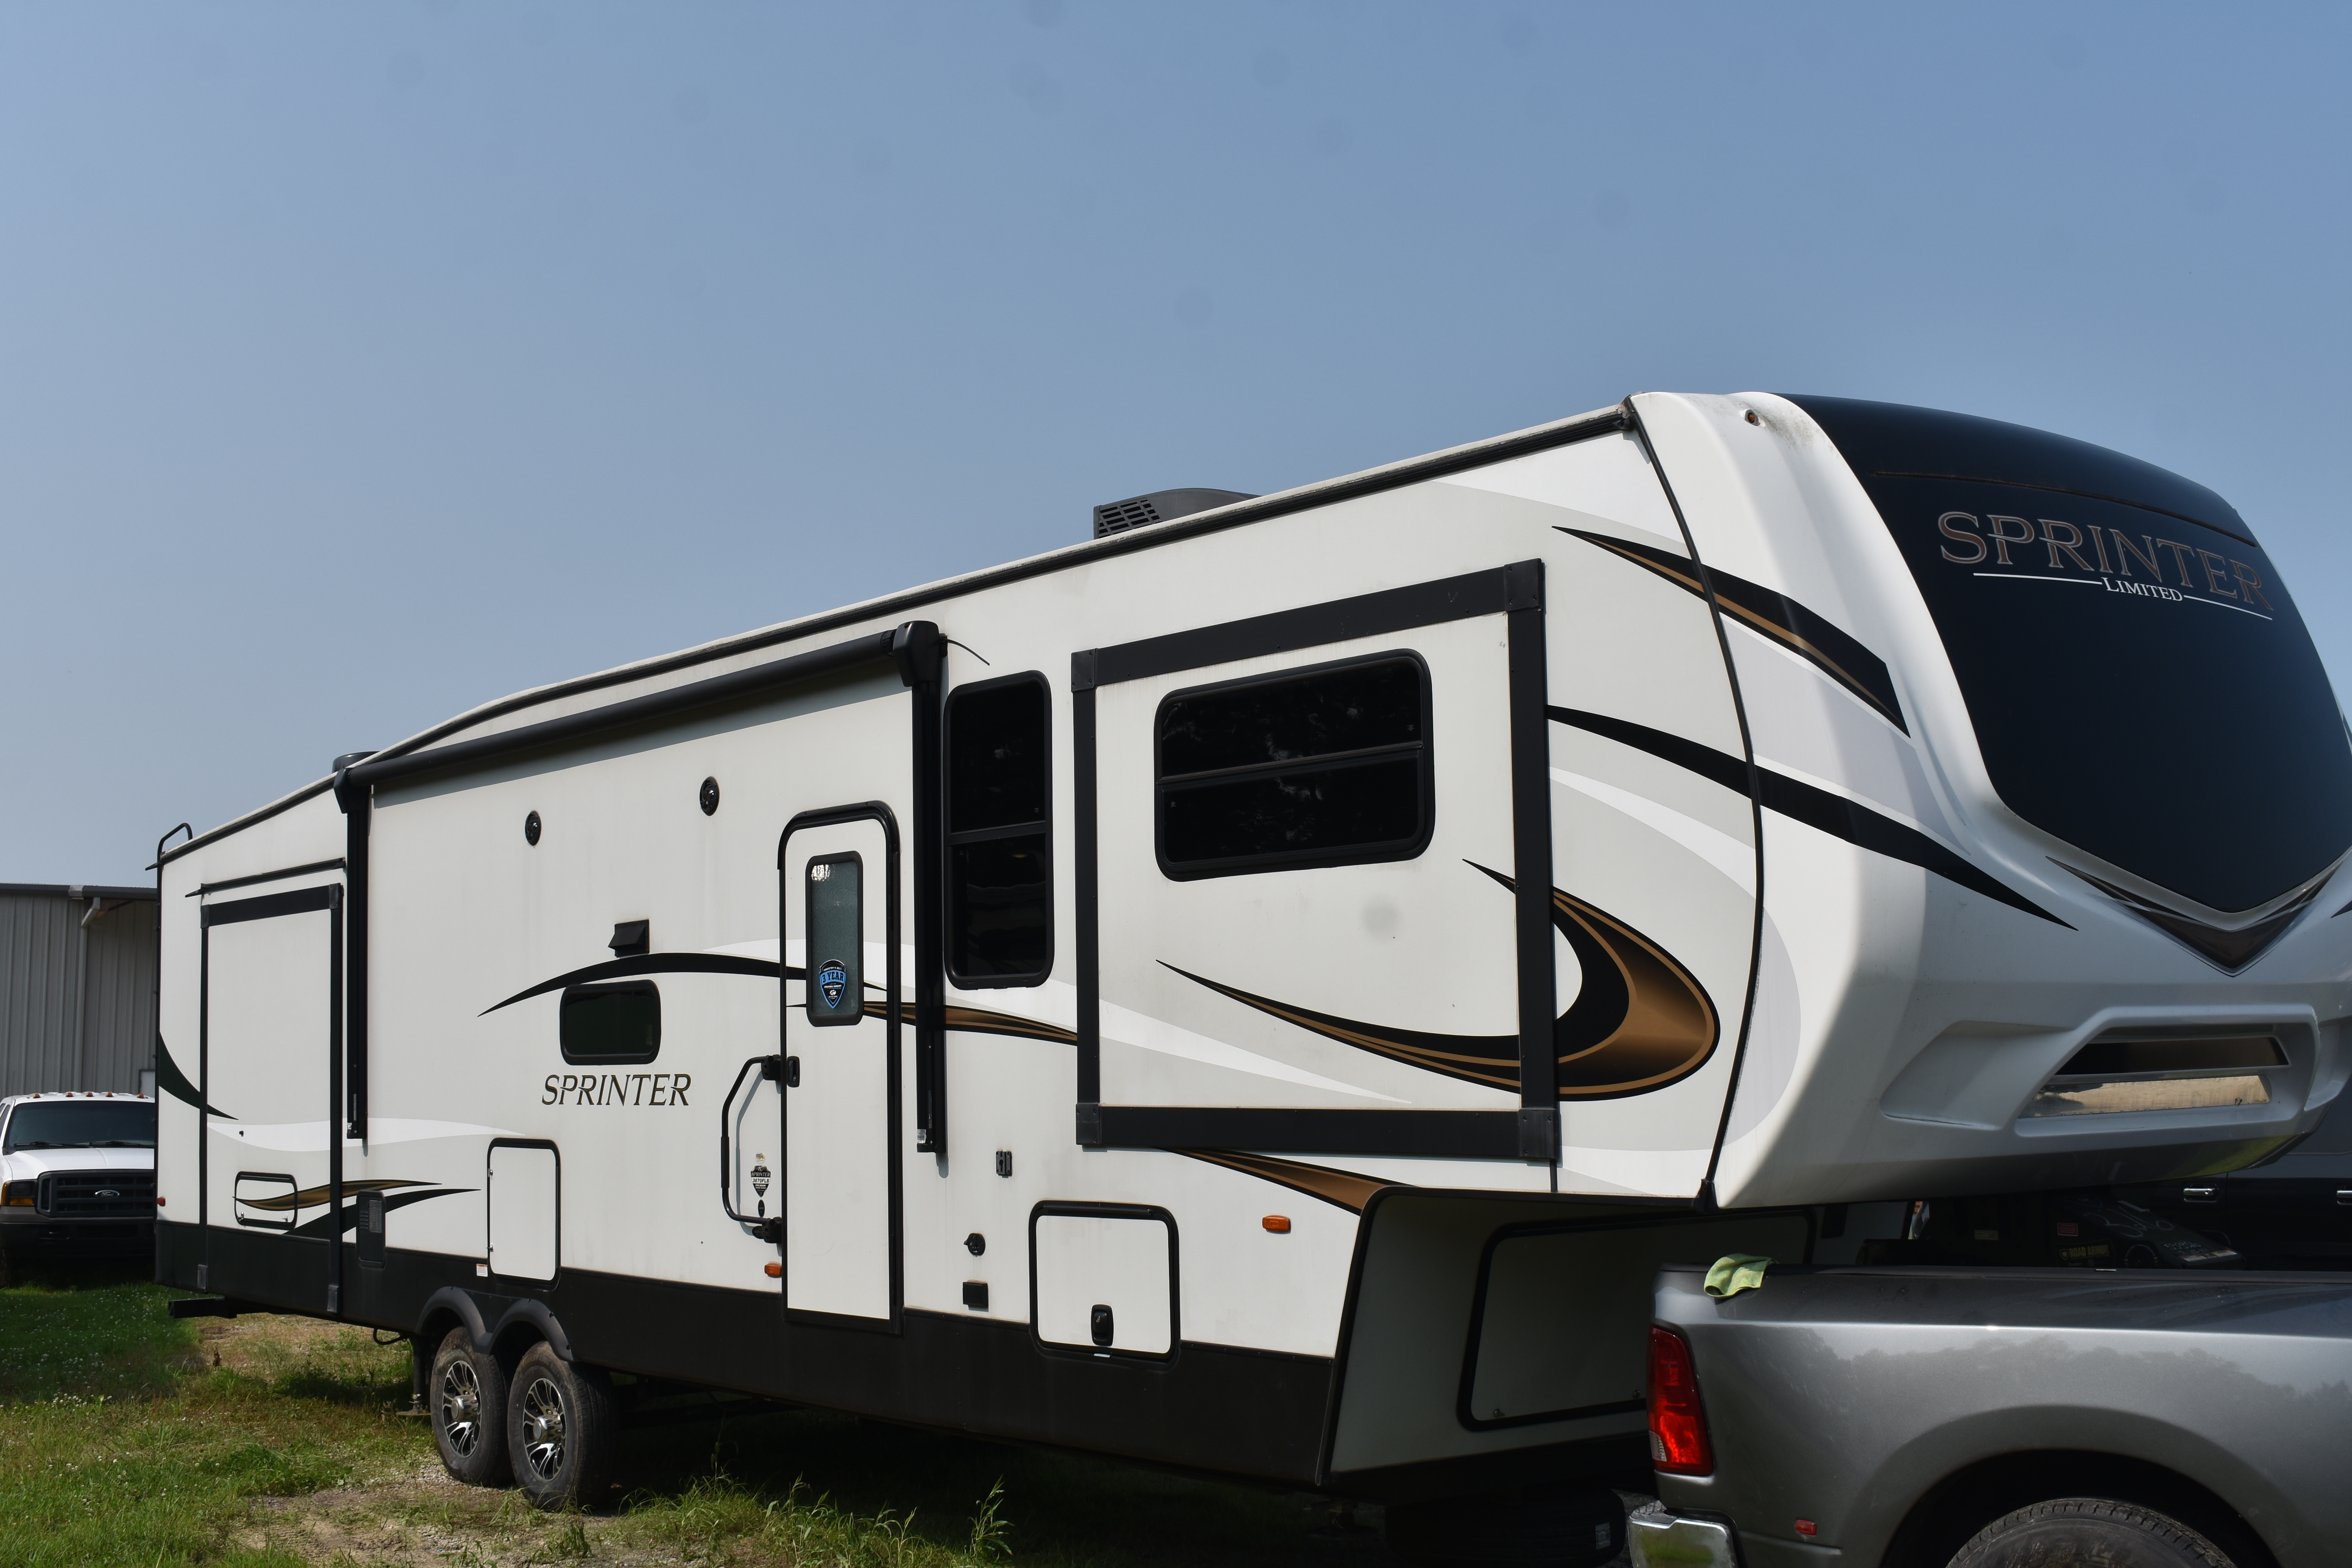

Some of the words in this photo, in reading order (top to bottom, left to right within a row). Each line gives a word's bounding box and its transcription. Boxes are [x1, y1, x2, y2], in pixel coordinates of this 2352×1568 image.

[1937, 511, 2273, 610] SPRINTER
[2101, 577, 2183, 601] LIMITED
[822, 974, 826, 983] 3
[827, 971, 844, 981] YEAR
[542, 1074, 691, 1107] SPRINTER
[2069, 1247, 2087, 1258] ROAD
[2087, 1244, 2110, 1255] ARMOR
